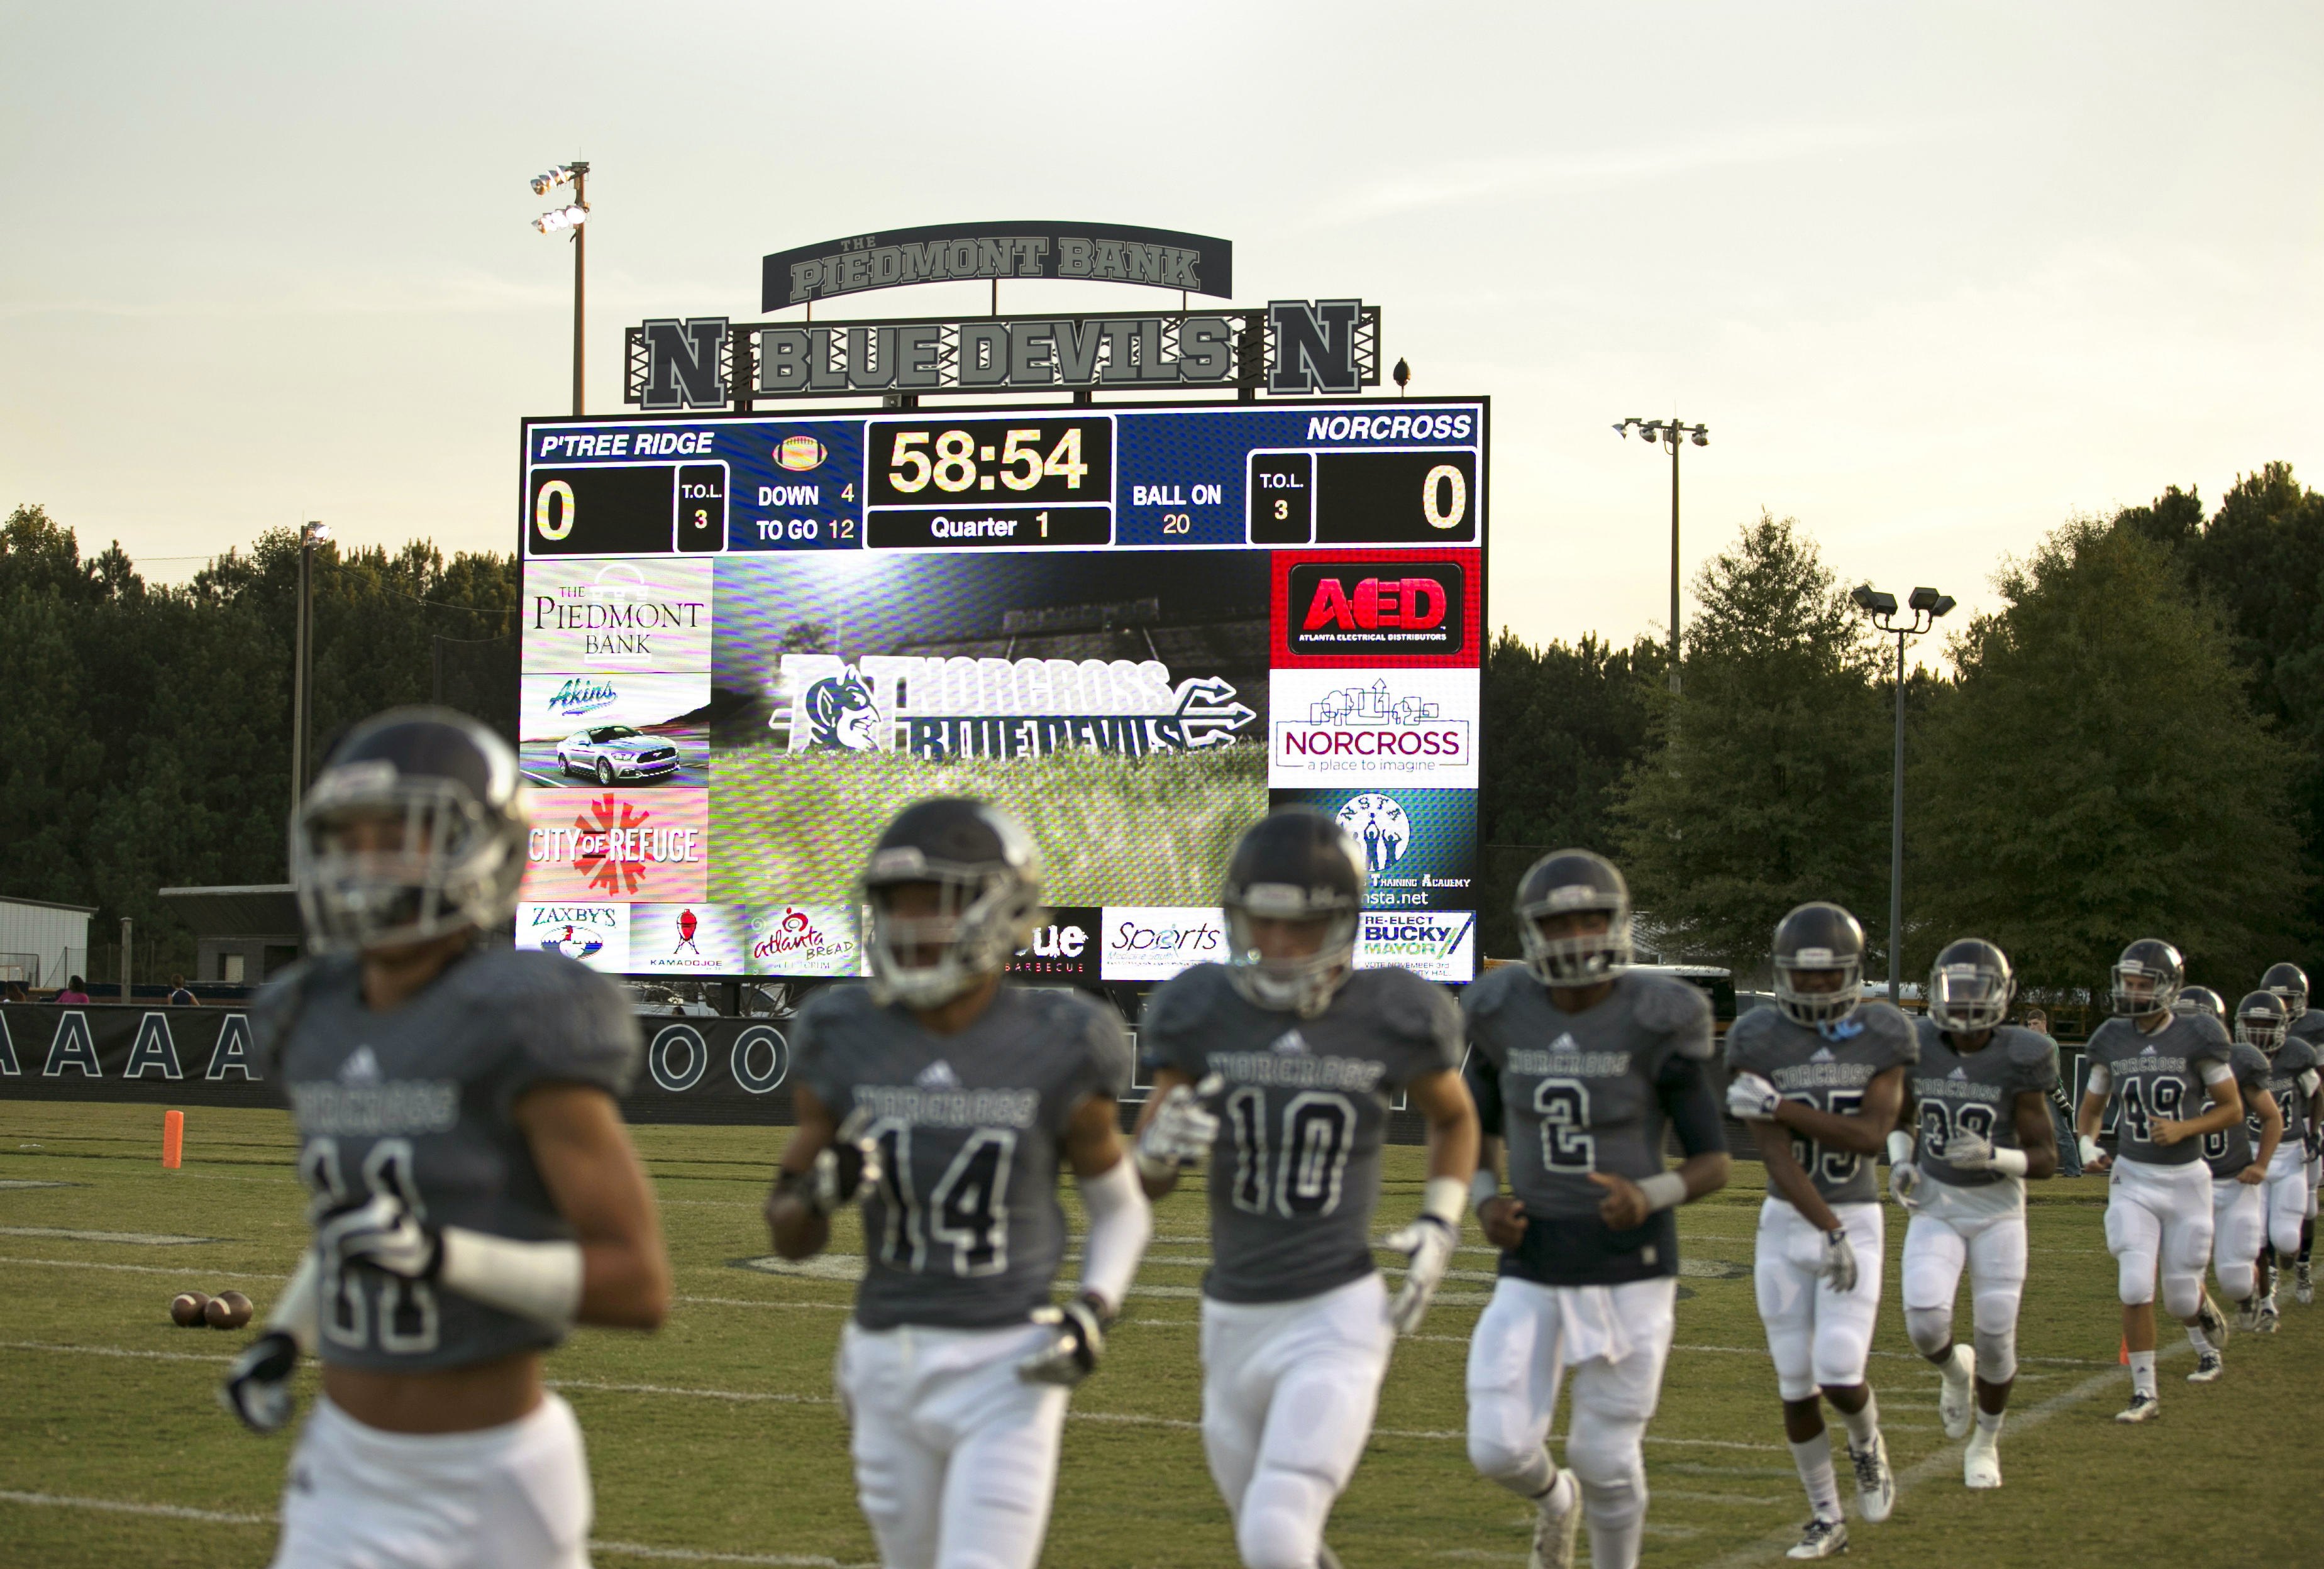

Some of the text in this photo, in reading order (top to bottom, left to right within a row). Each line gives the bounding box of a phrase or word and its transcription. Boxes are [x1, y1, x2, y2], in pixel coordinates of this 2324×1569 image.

[841, 235, 876, 252] THE
[790, 236, 1200, 303] PIEDMONT BANK
[759, 317, 1232, 393] BLUE DEVILS
[1268, 299, 1362, 395] N
[641, 317, 729, 410] N
[1307, 416, 1471, 439] NORCROSS
[540, 431, 714, 457] P'TREE RIDGE
[888, 428, 1088, 492] 58:54
[682, 483, 722, 499] T.O.L.
[1260, 473, 1303, 488] T.O.L.
[758, 483, 855, 505] DOWN 4
[1132, 485, 1222, 505] BALL ON
[1423, 465, 1466, 528] 0
[536, 480, 575, 540] 0
[695, 510, 708, 529] 3
[1274, 500, 1288, 519] 3
[756, 519, 855, 539] TO GO 12
[931, 512, 1048, 538] Quarter 1
[1163, 514, 1190, 534] 20
[559, 586, 585, 597] THE
[534, 595, 704, 629] PIEDMONT
[585, 634, 651, 654] BANK
[548, 678, 617, 711] Akins
[1286, 731, 1459, 755] NORCROSS
[1308, 759, 1435, 773] a place to imagine
[529, 828, 699, 862] CITY OF REFUGE
[533, 907, 616, 928] ZAXBY'S
[1365, 916, 1434, 925] RE-ELECT
[754, 926, 824, 958] atlanta
[1031, 924, 1088, 960] ue
[1112, 922, 1220, 951] Sports
[1365, 926, 1451, 941] BUCKY
[807, 942, 853, 960] BREAD
[1364, 943, 1436, 955] MAYOR
[1005, 963, 1083, 972] BARBECUE
[1771, 1063, 1877, 1090] NORCROSS
[2111, 1057, 2186, 1076] NORCROSS
[1912, 1077, 2001, 1102] NORCROSS
[2122, 1076, 2186, 1142] 49
[1534, 1077, 1595, 1174] 2
[1226, 1085, 1358, 1218] 10
[871, 1117, 1017, 1277] 14
